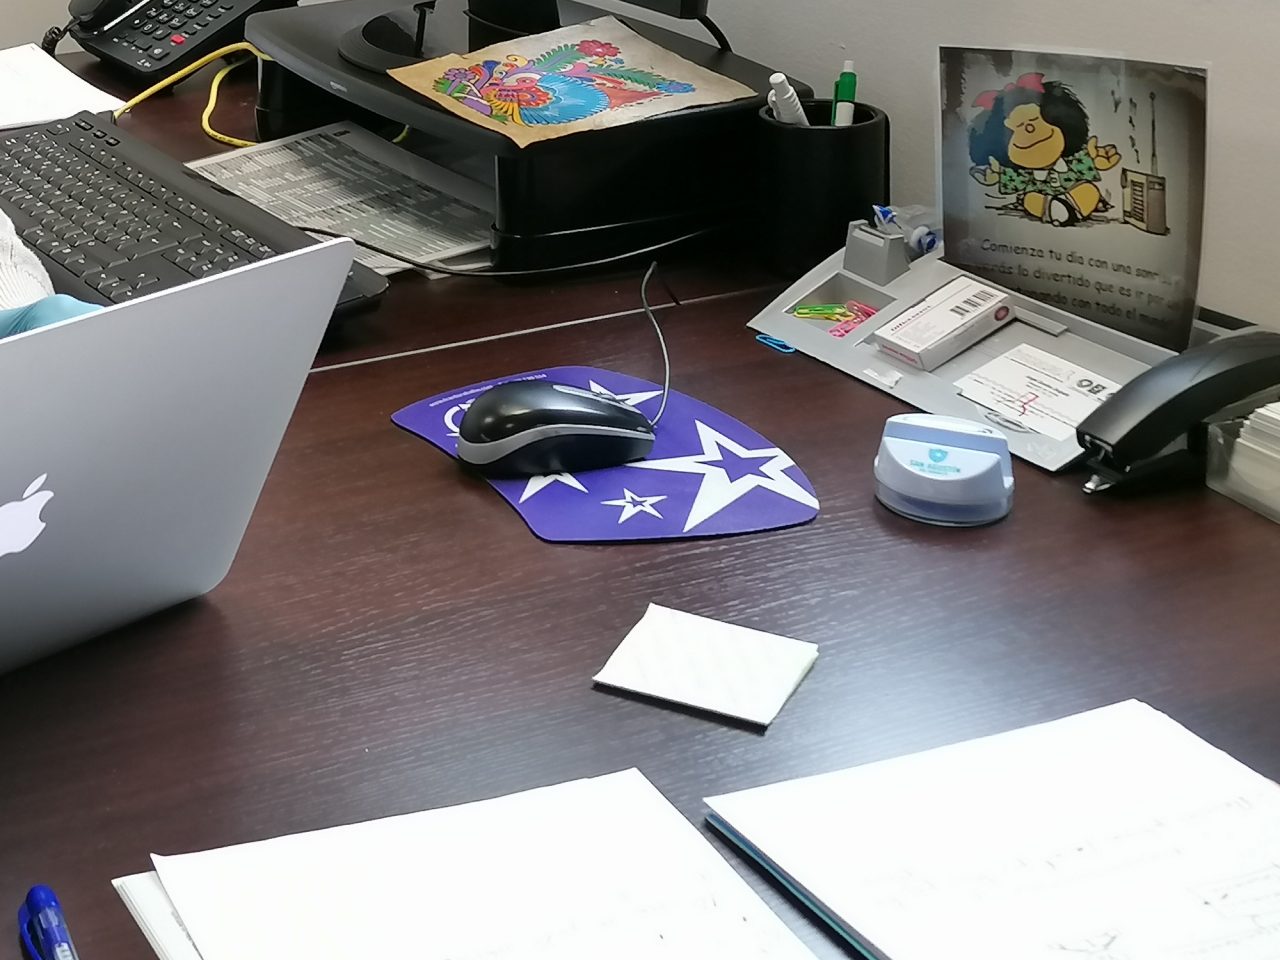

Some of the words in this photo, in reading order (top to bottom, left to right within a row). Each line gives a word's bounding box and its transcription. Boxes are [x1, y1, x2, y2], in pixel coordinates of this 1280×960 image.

[980, 238, 1045, 259] Comienza
[1048, 248, 1062, 261] tu
[1088, 257, 1109, 270] con
[1112, 262, 1132, 276] una
[1033, 266, 1091, 289] divertido
[1094, 280, 1114, 295] que
[1118, 285, 1132, 298] es
